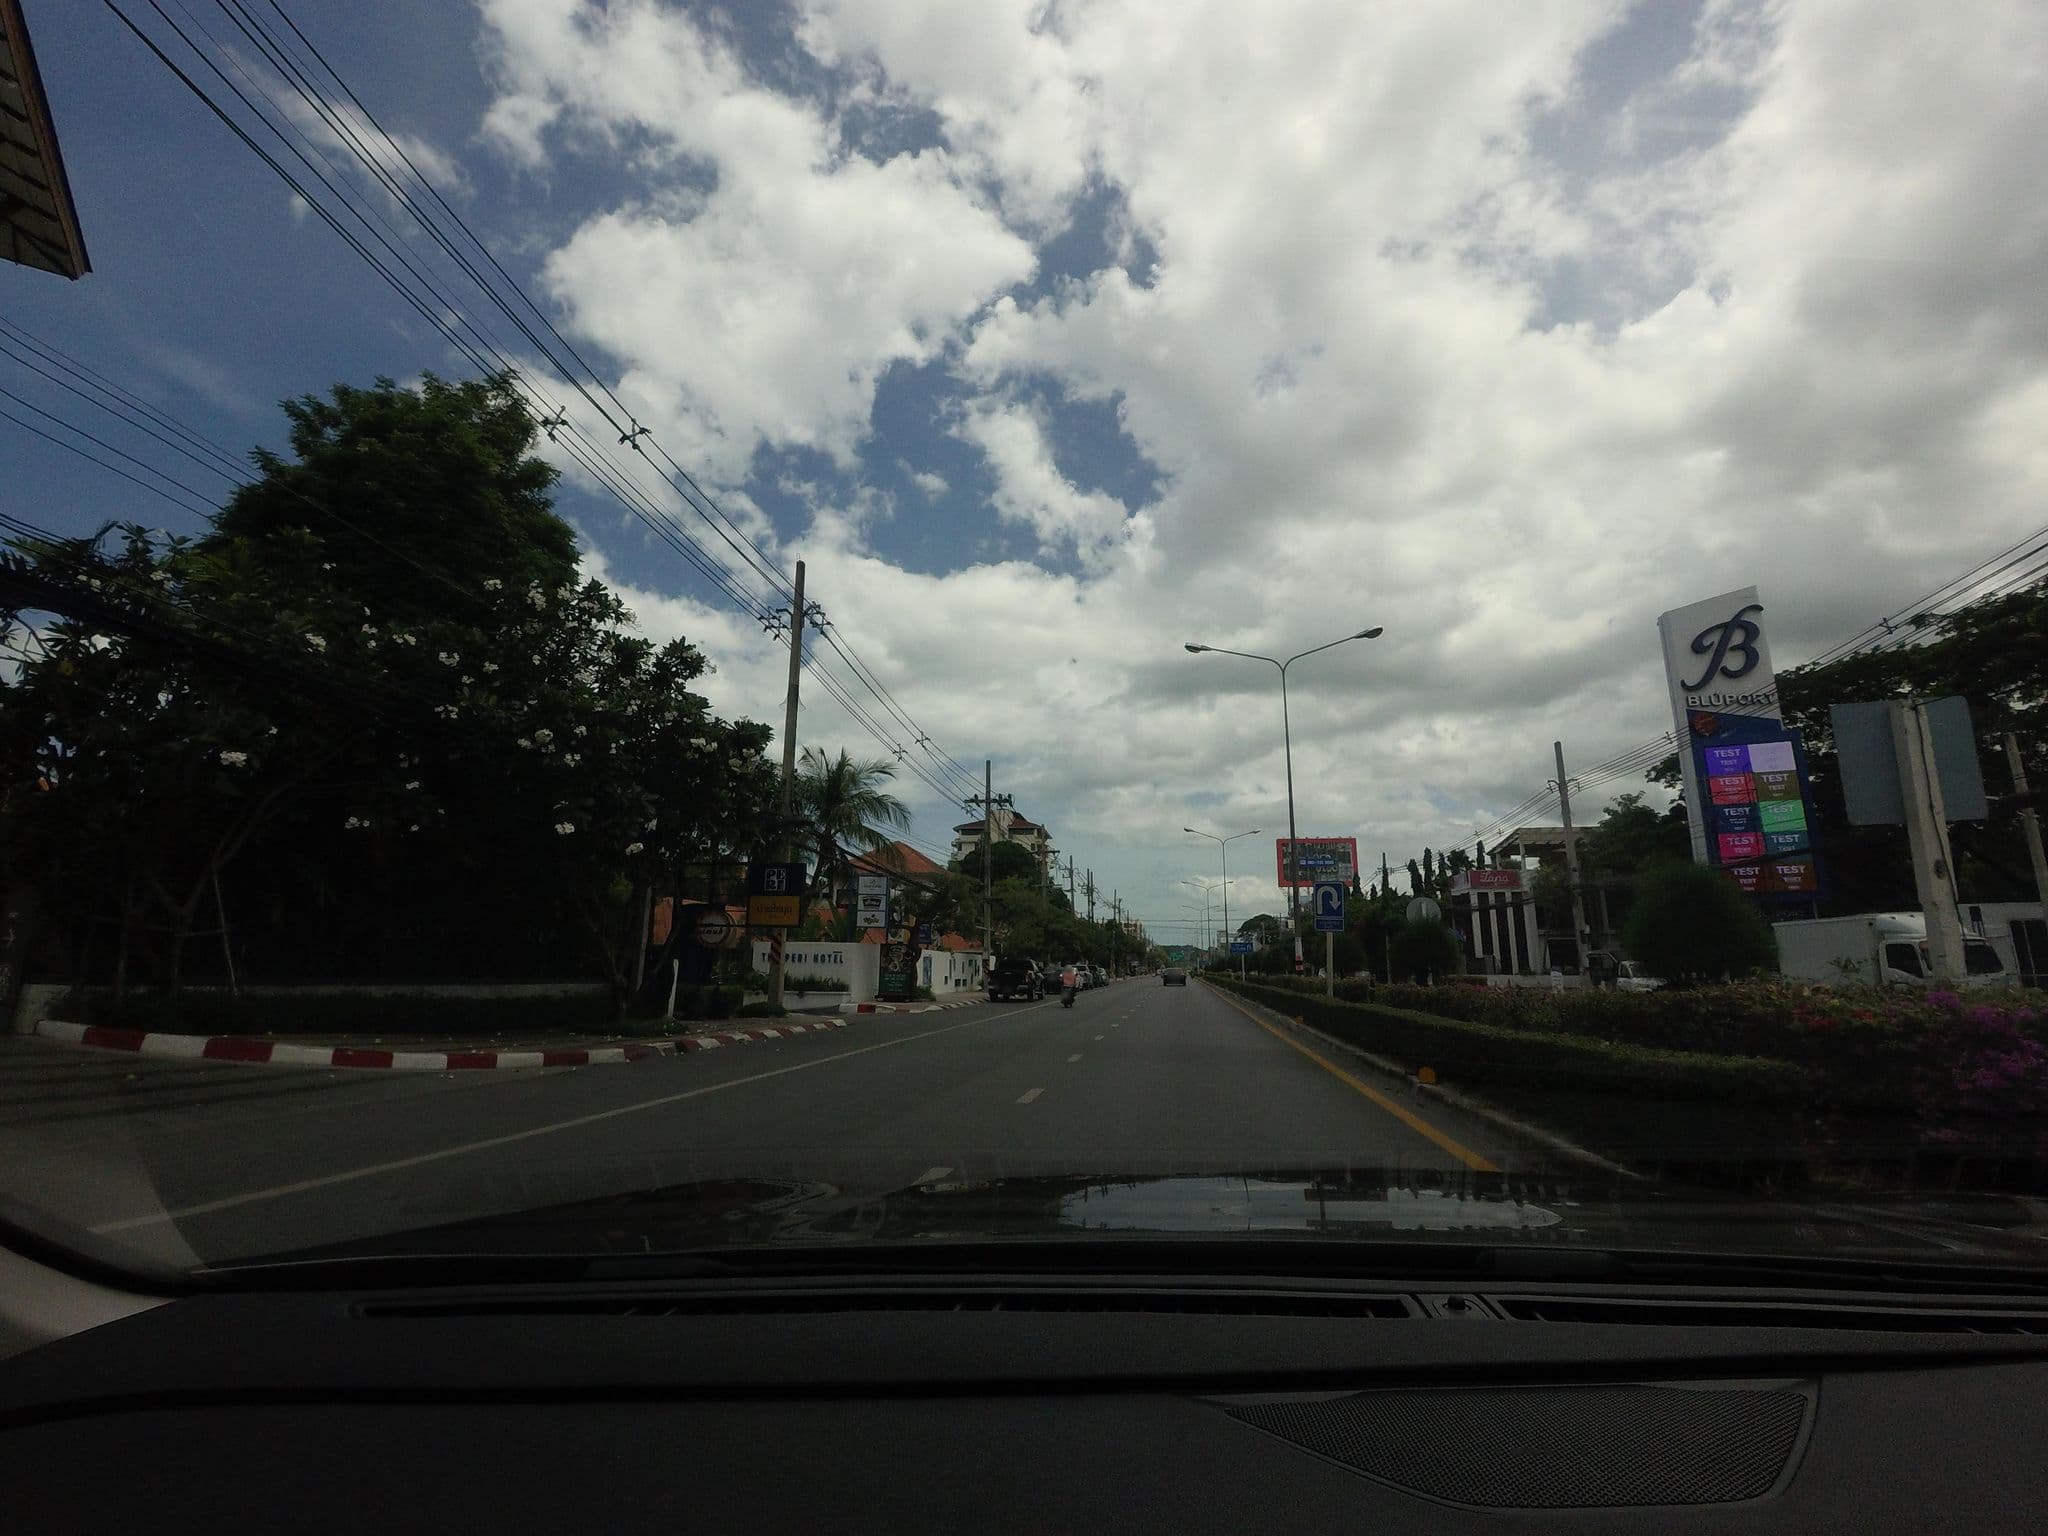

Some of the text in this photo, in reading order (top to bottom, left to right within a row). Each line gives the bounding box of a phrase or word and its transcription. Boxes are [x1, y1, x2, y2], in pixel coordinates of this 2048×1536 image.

[1713, 748, 1742, 758] TEST
[1719, 776, 1745, 785] TEST
[1761, 774, 1790, 783] TEST
[1723, 807, 1752, 816] TEST
[1727, 837, 1756, 846] TEST
[1770, 834, 1800, 844] TEST
[1732, 866, 1760, 876] TEST
